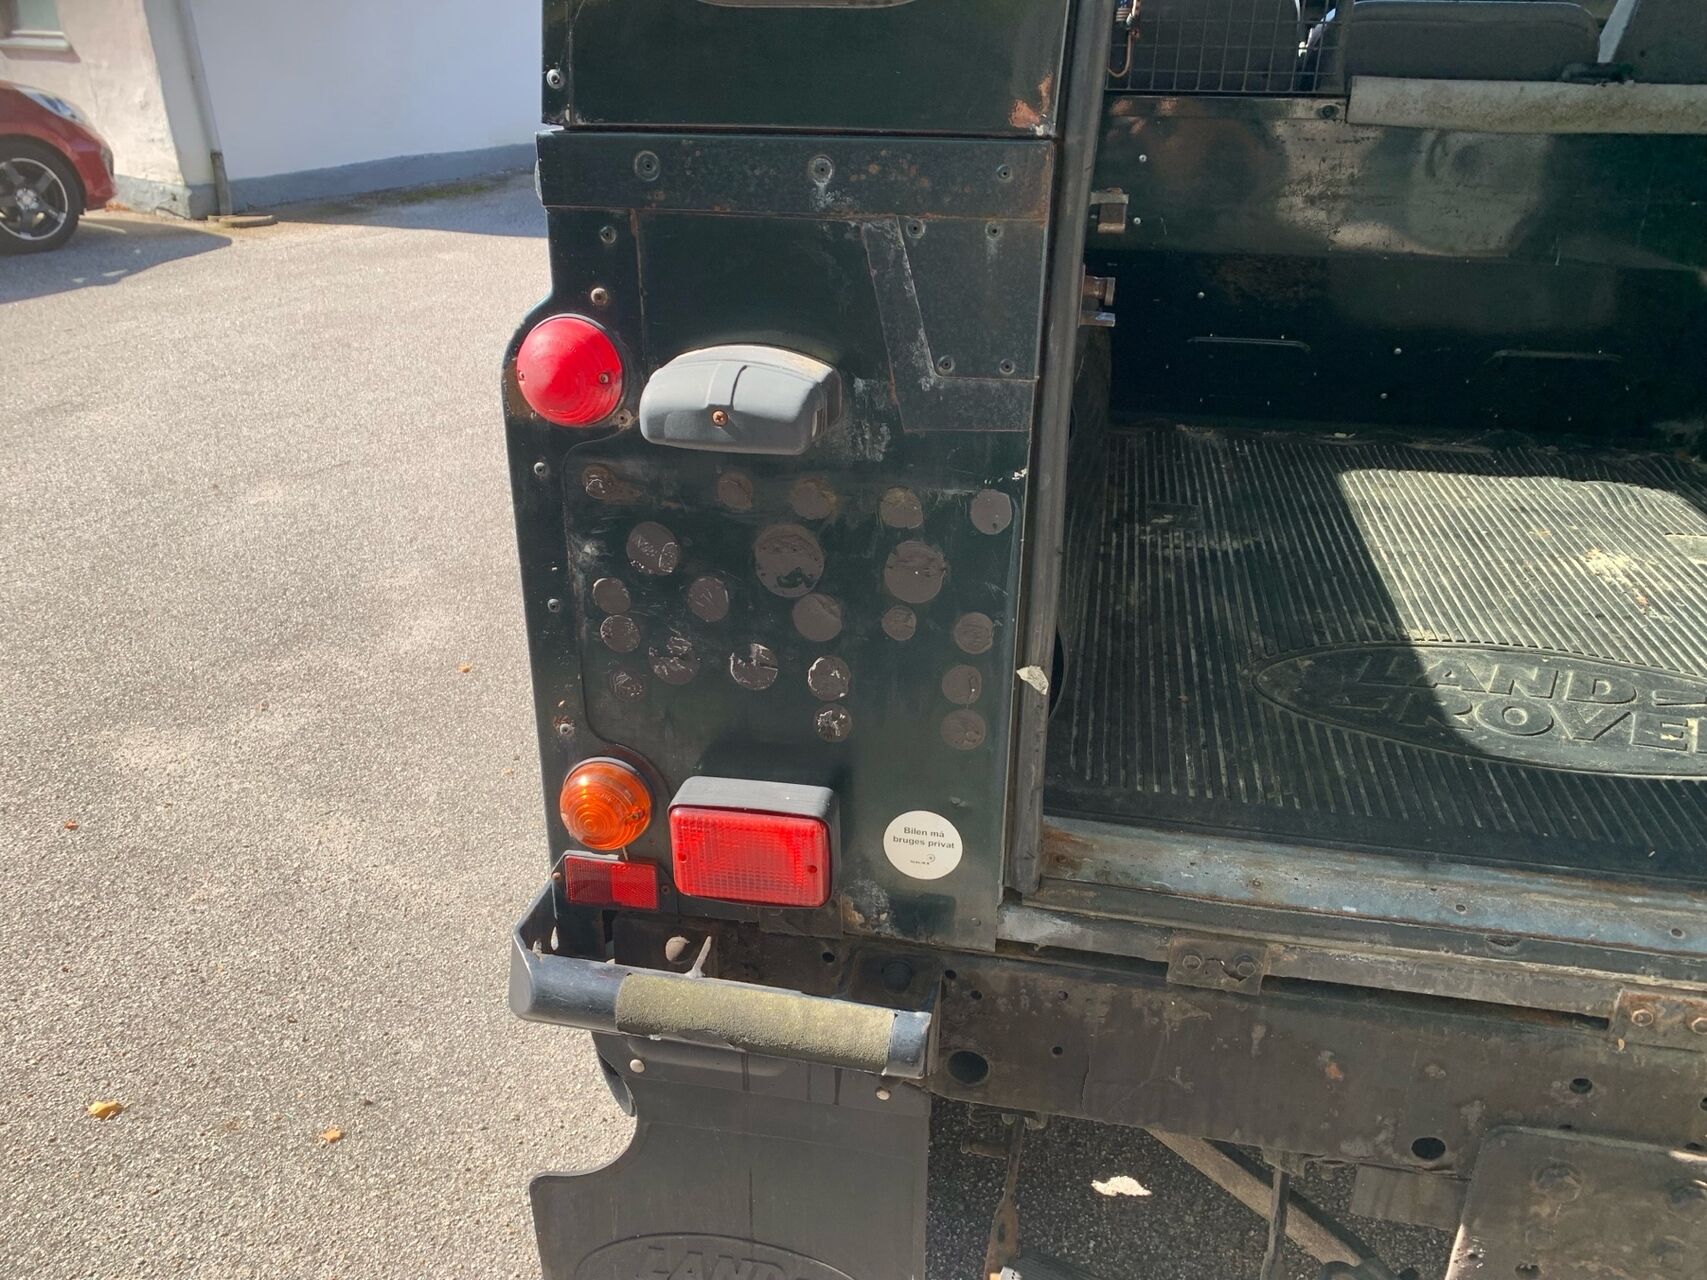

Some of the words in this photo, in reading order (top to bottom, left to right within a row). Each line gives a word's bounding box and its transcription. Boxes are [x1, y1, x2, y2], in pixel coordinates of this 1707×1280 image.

[1356, 655, 1638, 704] LAND
[903, 826, 927, 835] Bilen
[930, 830, 944, 838] må
[893, 836, 925, 845] bruges
[928, 840, 954, 848] privat
